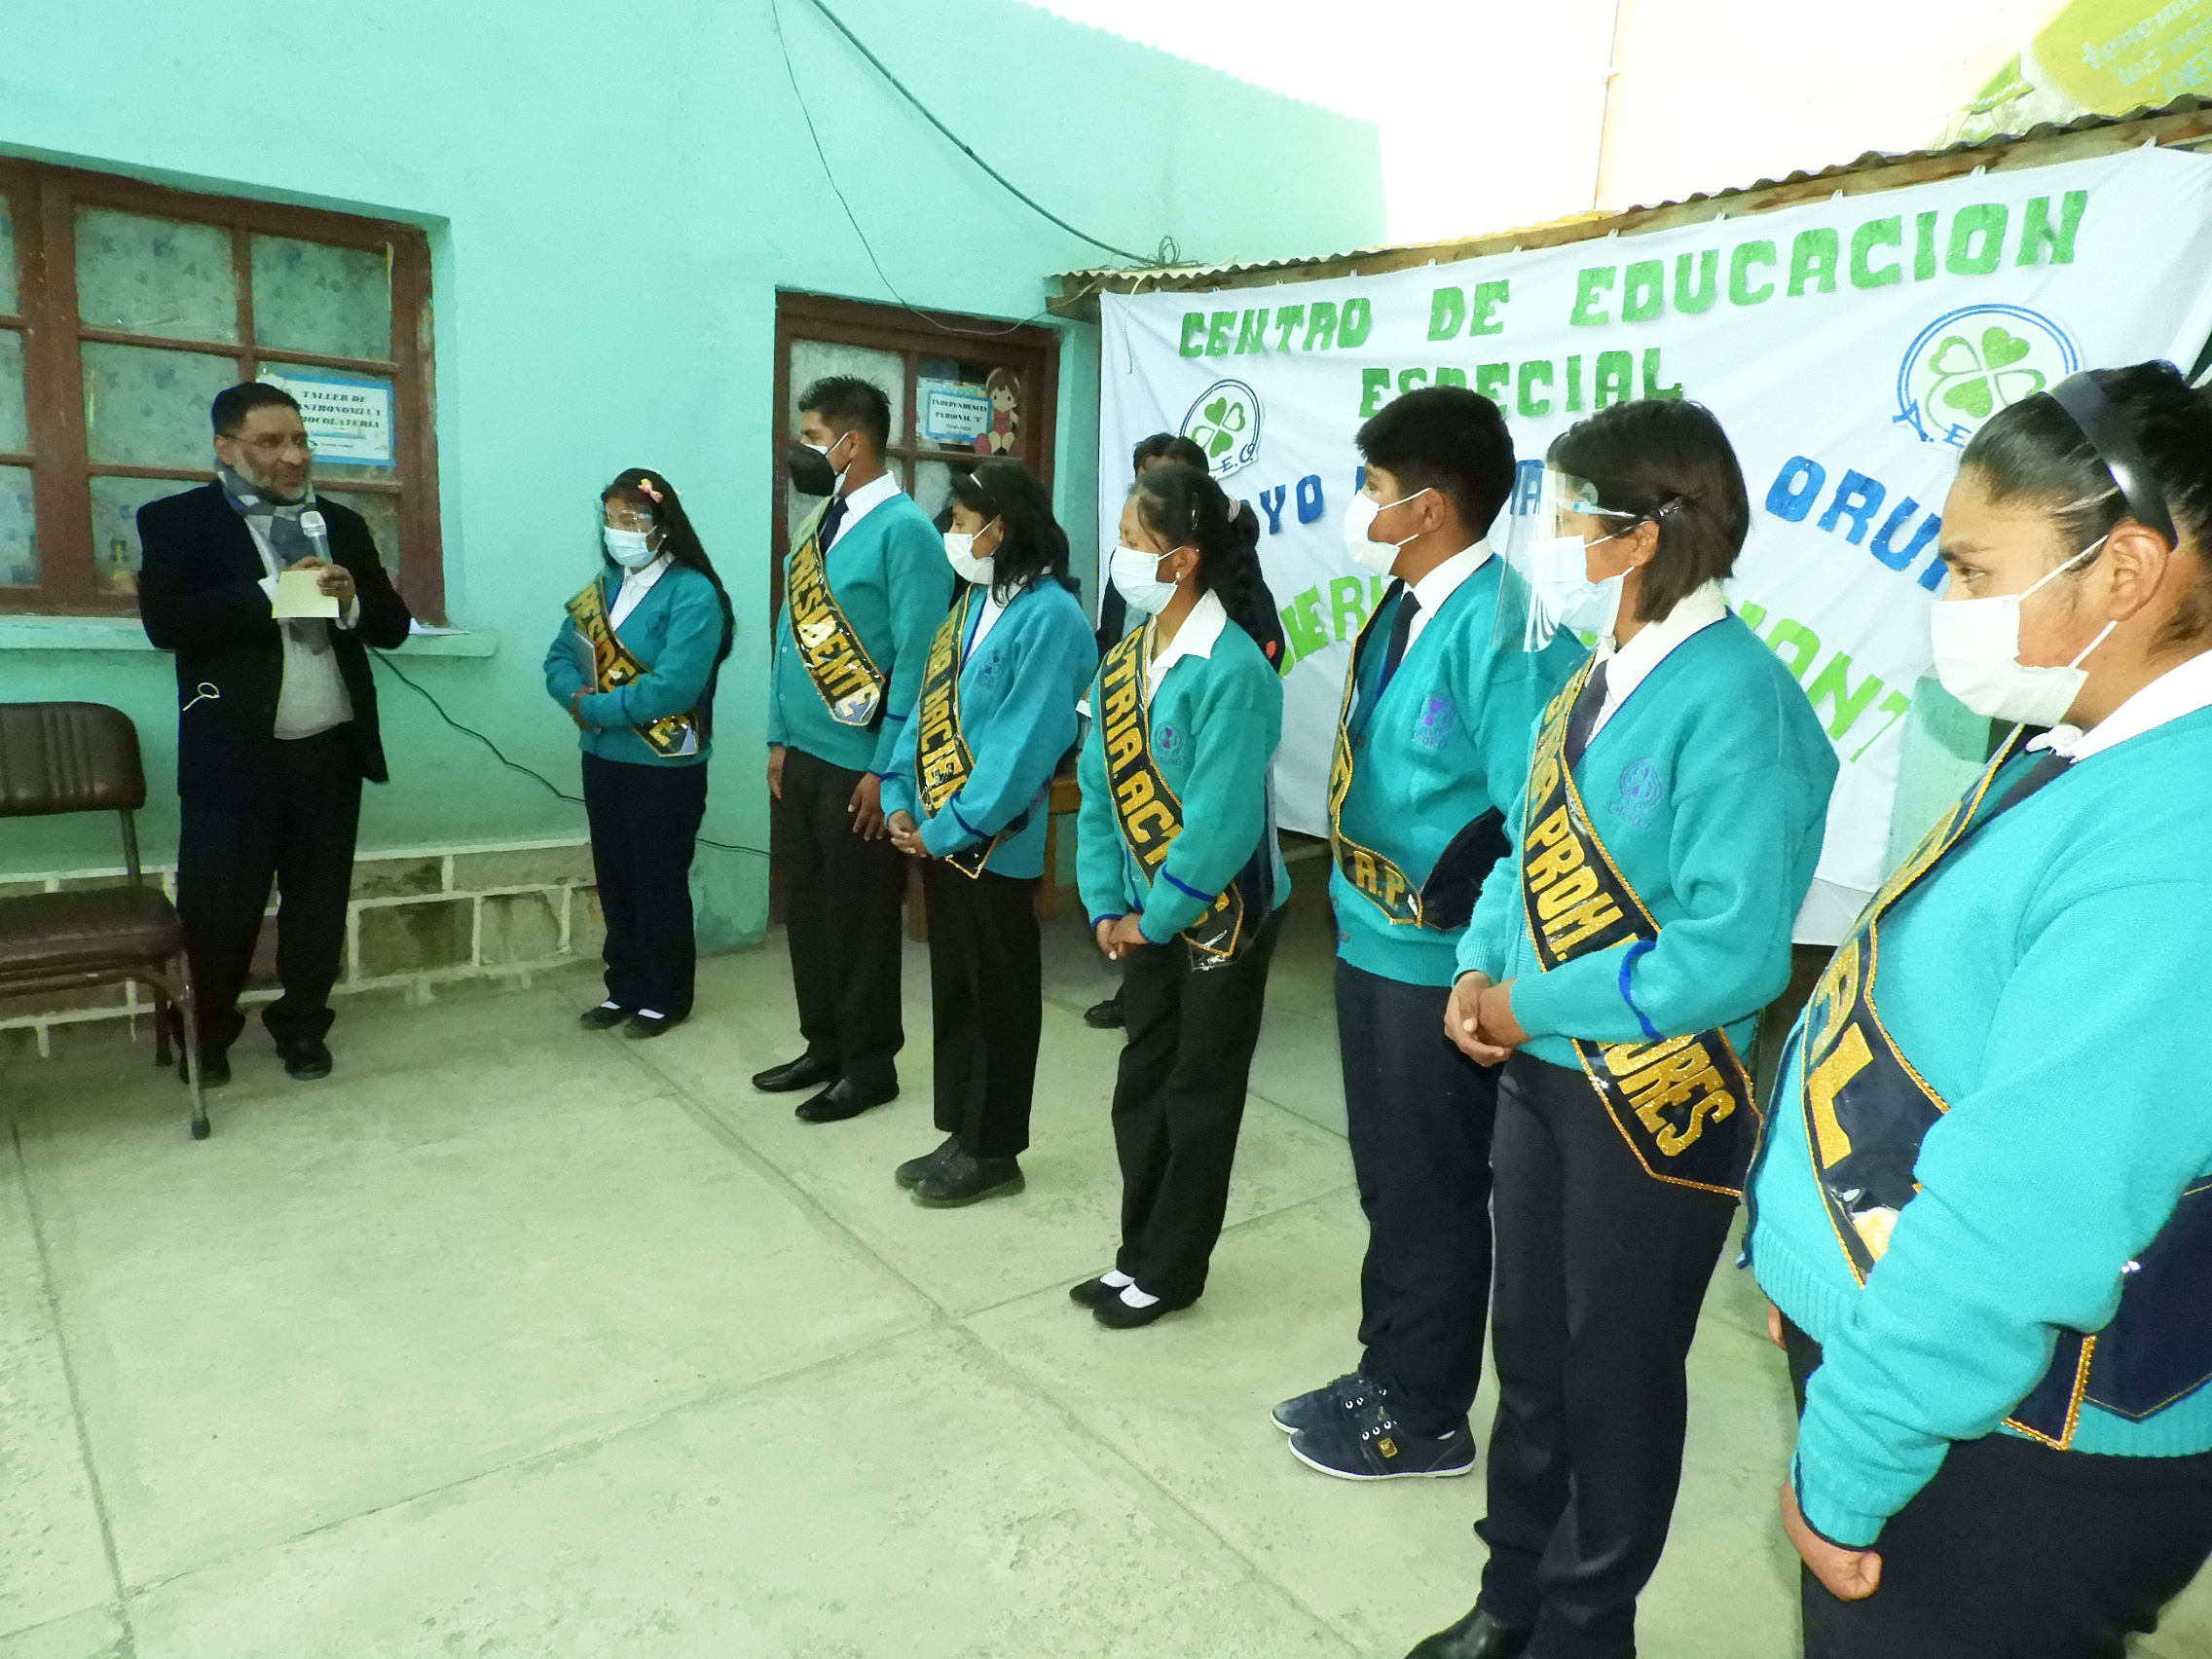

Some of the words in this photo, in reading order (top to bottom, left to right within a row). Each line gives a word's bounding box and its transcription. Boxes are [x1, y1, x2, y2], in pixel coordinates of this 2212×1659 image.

[1179, 298, 1372, 358] CENTRO
[1427, 279, 1510, 341] DE
[1569, 190, 2087, 326] EDUCACION
[299, 403, 372, 416] ASTRONOMIA
[301, 416, 381, 428] HOCOLATERIA
[304, 391, 349, 402] TALLER
[1765, 456, 1949, 592] ORU
[790, 538, 881, 718] PRESIDENTE
[1526, 804, 1624, 962] PROM.
